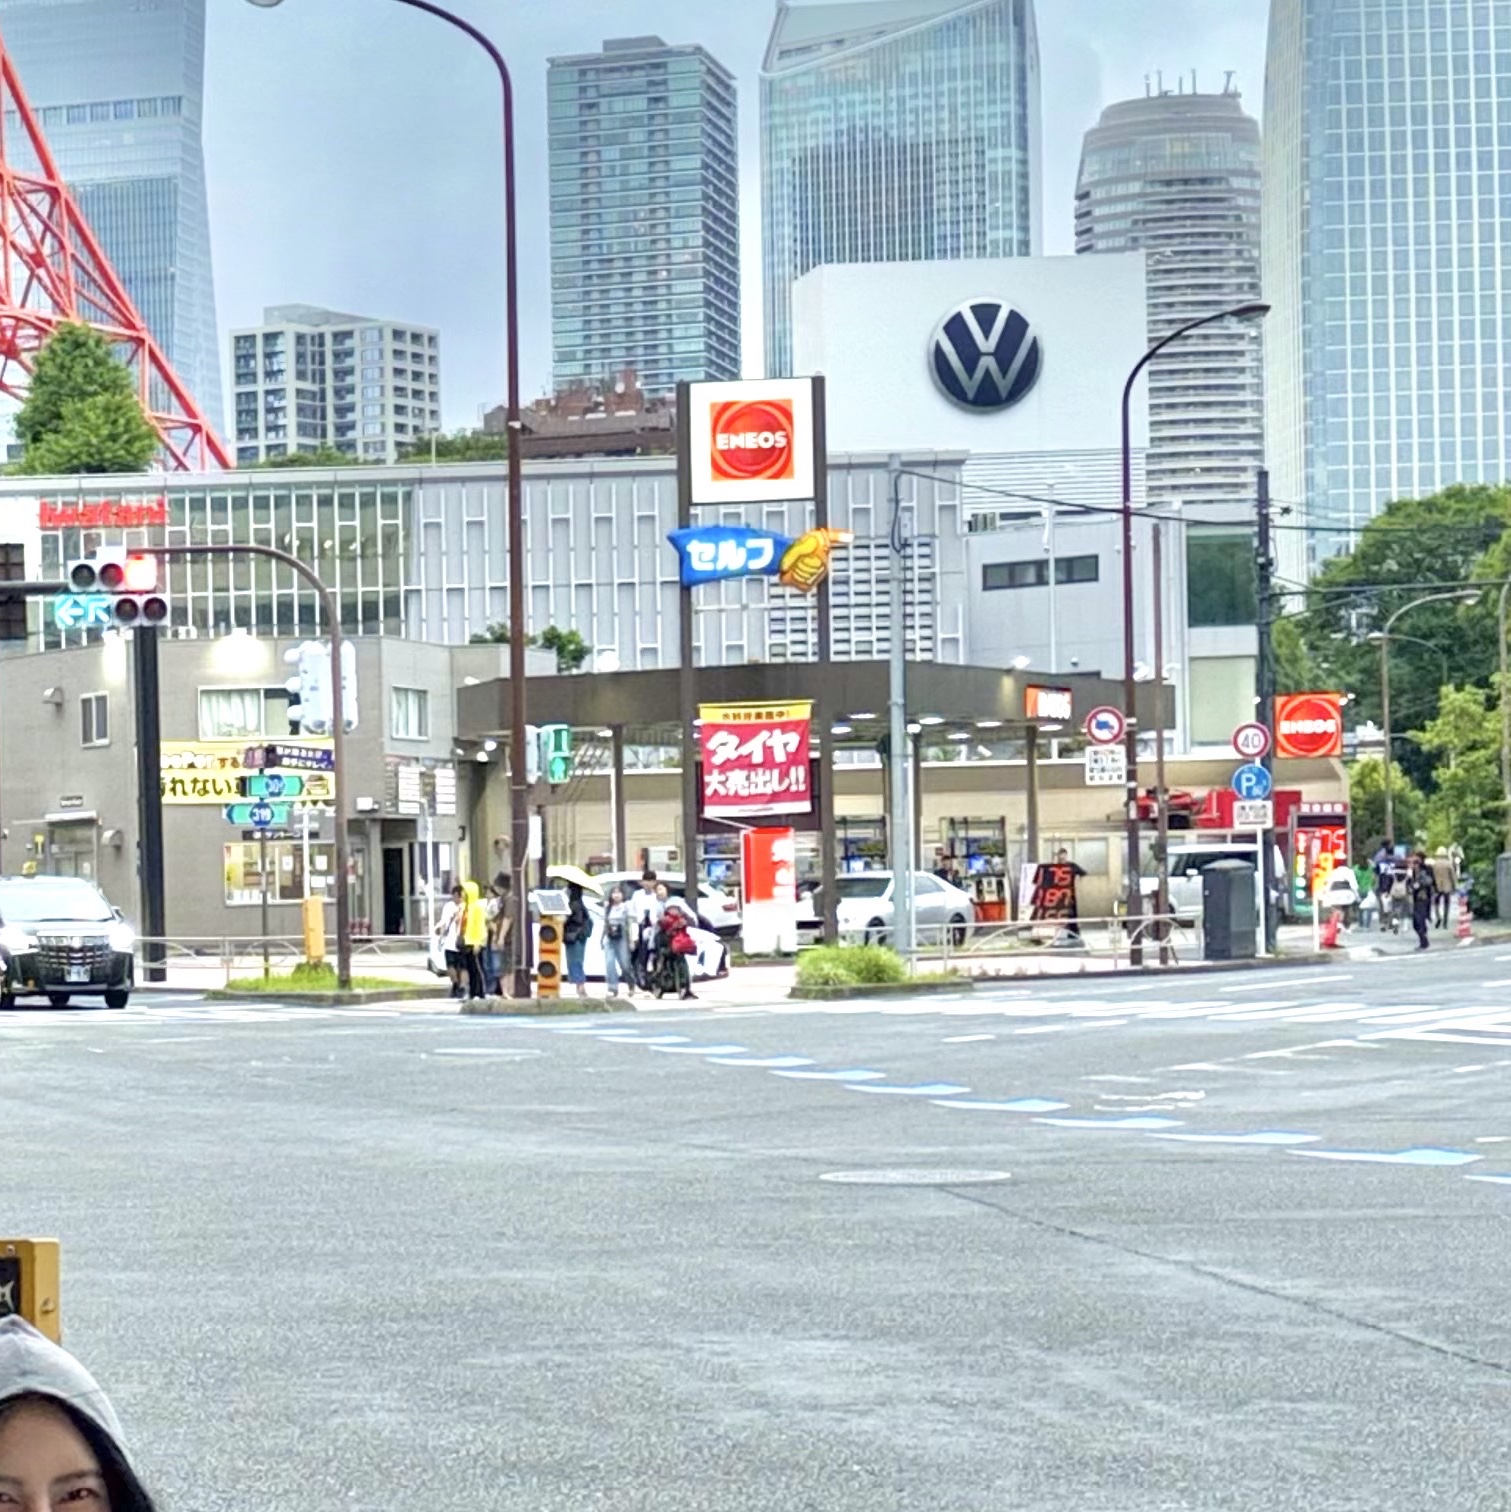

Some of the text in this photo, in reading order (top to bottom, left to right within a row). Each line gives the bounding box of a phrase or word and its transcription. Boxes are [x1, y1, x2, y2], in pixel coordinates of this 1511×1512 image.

[933, 299, 1038, 405] VW
[716, 431, 787, 450] ENEOS
[687, 538, 774, 571] セルフ
[706, 728, 801, 765] タイヤ
[1241, 733, 1261, 748] 40
[160, 776, 242, 797] れない
[252, 808, 271, 822] 319
